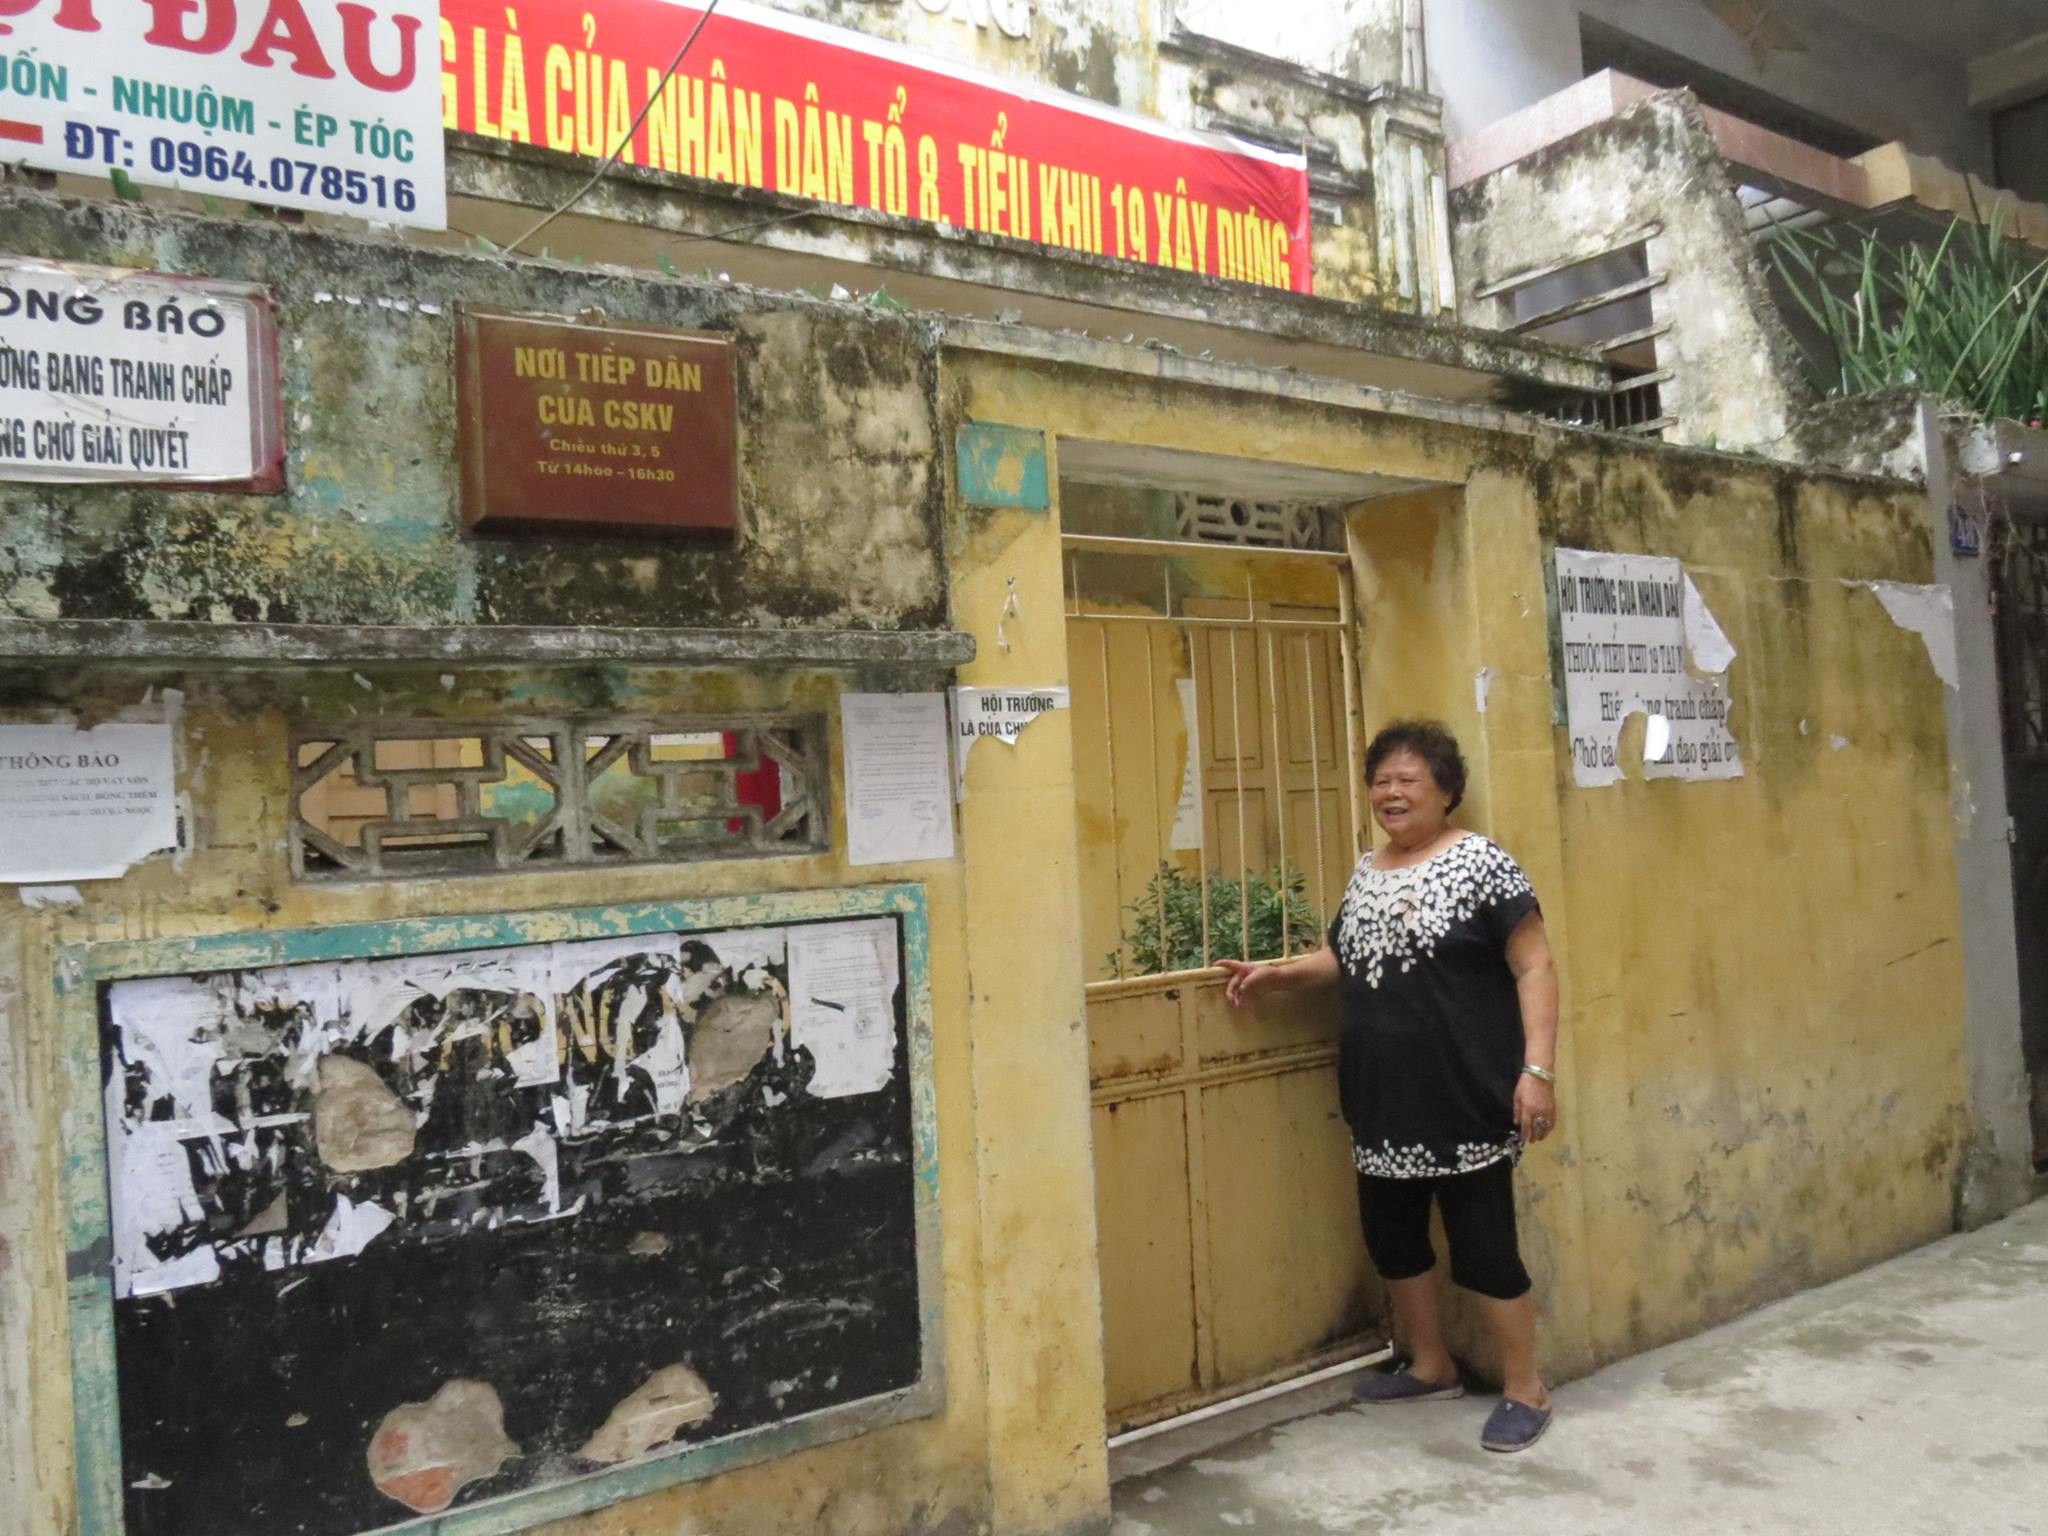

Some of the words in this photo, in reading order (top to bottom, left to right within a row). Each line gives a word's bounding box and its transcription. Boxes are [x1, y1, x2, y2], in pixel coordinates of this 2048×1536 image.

[112, 76, 254, 136] NHUỘM
[294, 104, 338, 147] ÉP
[350, 118, 414, 163] TÓC
[474, 7, 531, 143] LÀ
[545, 12, 634, 163] CỦA
[647, 58, 763, 188] NHÂN
[776, 82, 853, 205] DÂN
[863, 85, 907, 216] TỔ
[958, 111, 1030, 240] TIỂU
[1111, 183, 1147, 262] 19
[1155, 177, 1208, 274] XÂY
[64, 121, 134, 167] ĐT:
[150, 136, 416, 213] 0964.078516
[124, 296, 225, 338] BÁO
[47, 352, 104, 396] ĐANG
[110, 358, 175, 402] TRANH
[182, 353, 232, 406] CHẤP
[514, 347, 566, 379] NƠI
[575, 341, 636, 386] TIẾP
[645, 354, 702, 392] DÂN
[538, 384, 595, 427] CỦA
[604, 399, 674, 432] CSKV
[33, 411, 75, 462] CHỜ
[129, 416, 189, 472] QUYẾT
[960, 717, 976, 736] LÀ
[978, 715, 1002, 736] CỦA
[981, 694, 1002, 716] HỘI
[77, 750, 120, 768] BÁO
